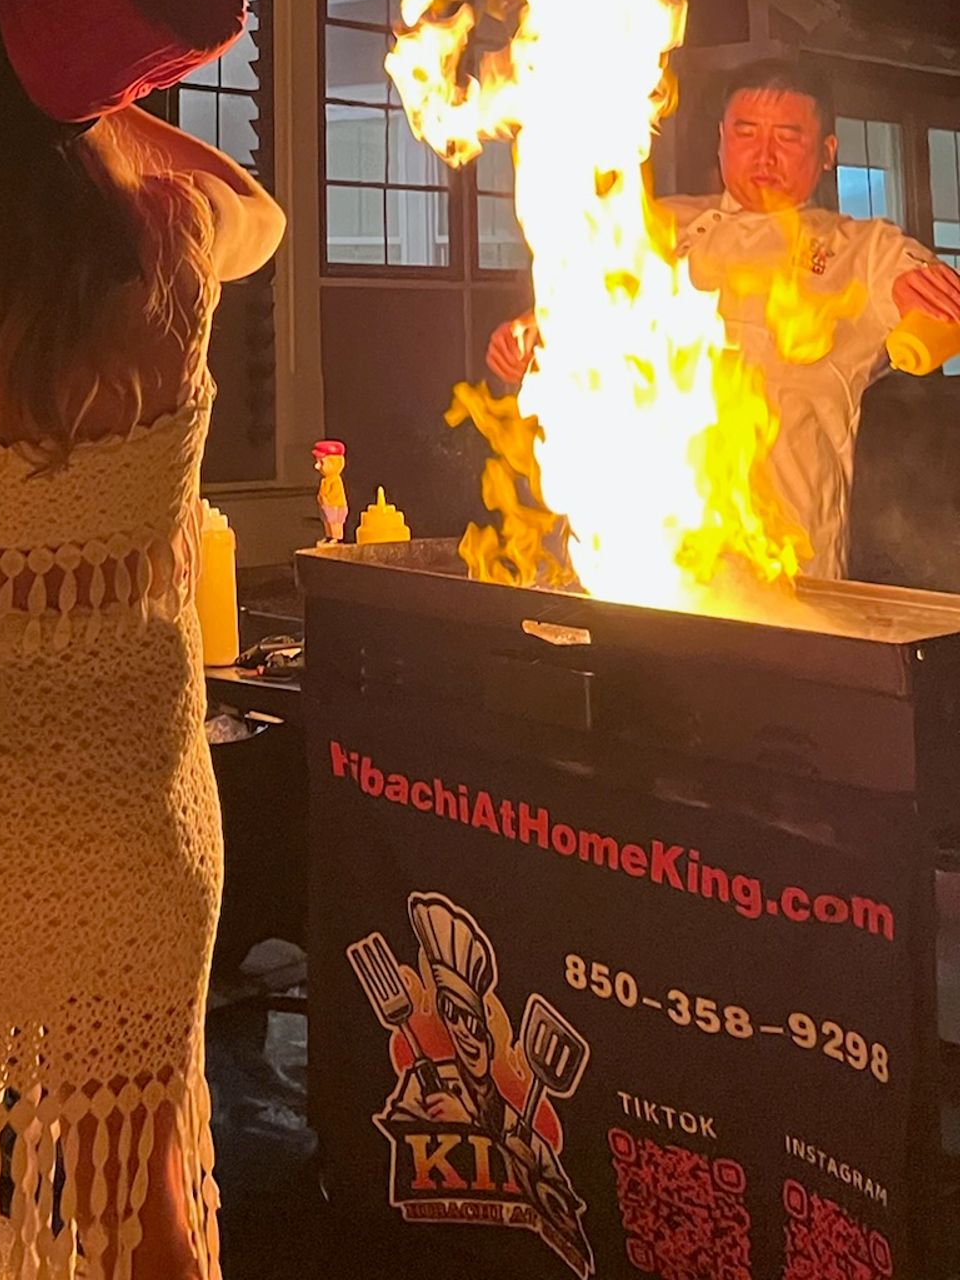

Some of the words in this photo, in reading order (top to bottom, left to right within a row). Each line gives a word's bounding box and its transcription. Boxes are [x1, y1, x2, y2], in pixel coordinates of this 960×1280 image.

[564, 954, 890, 1083] 850-358-9298
[617, 1091, 717, 1139] TIKTOK
[784, 1135, 888, 1207] INSTAGRAM
